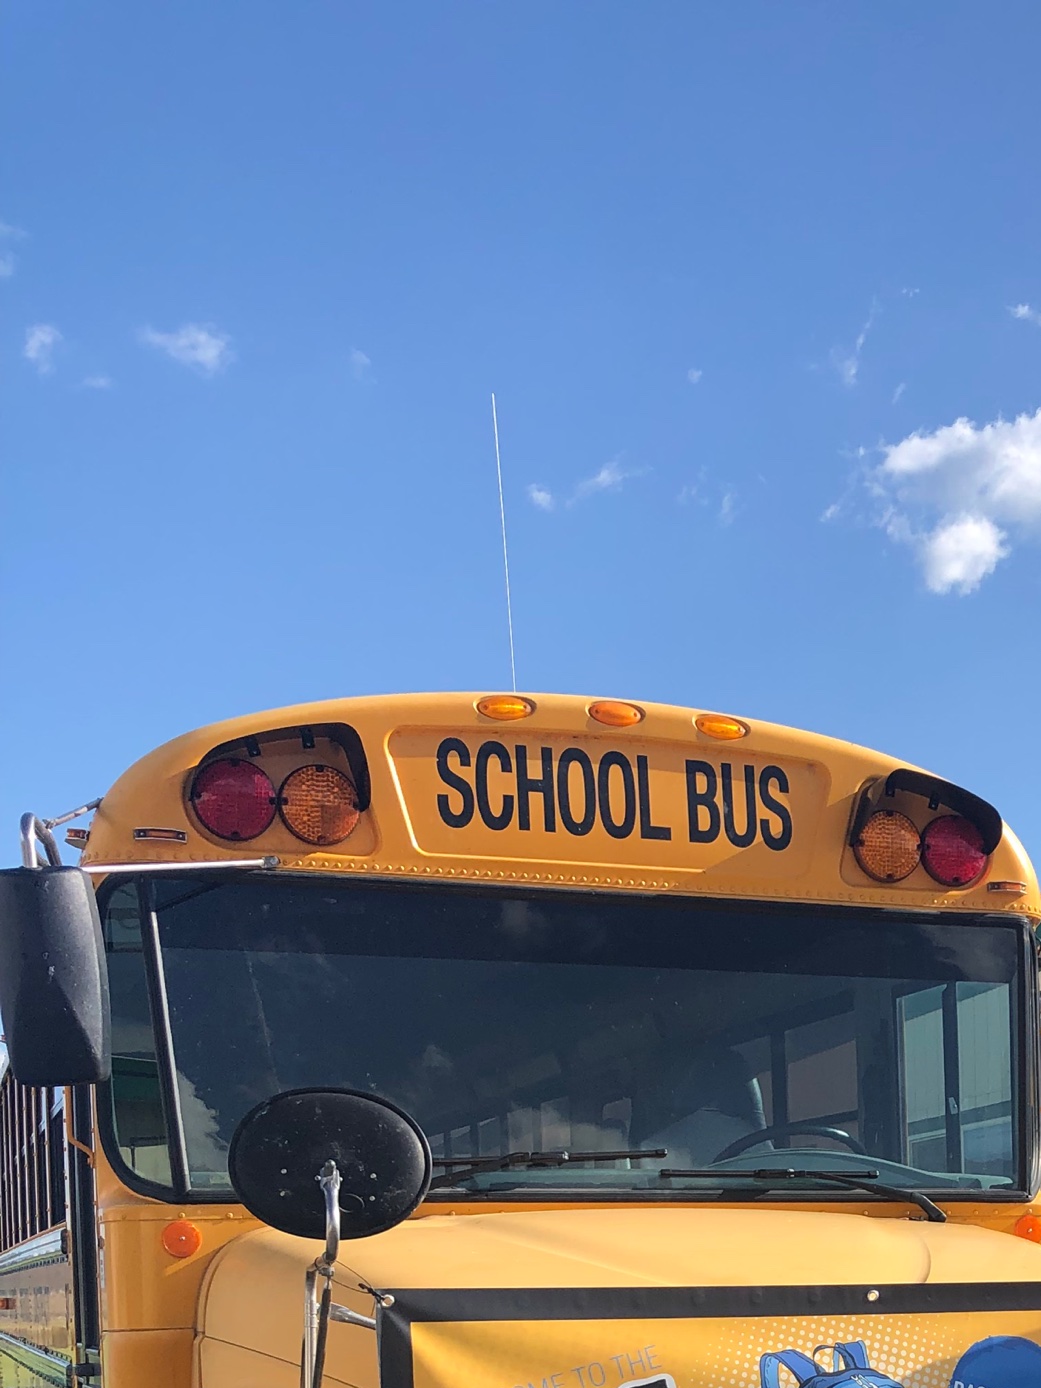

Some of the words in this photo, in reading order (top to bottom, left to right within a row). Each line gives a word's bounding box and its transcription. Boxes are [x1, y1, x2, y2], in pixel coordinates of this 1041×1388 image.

[436, 737, 672, 841] SCHOOL
[685, 759, 793, 851] BUS
[609, 1345, 663, 1379] THE
